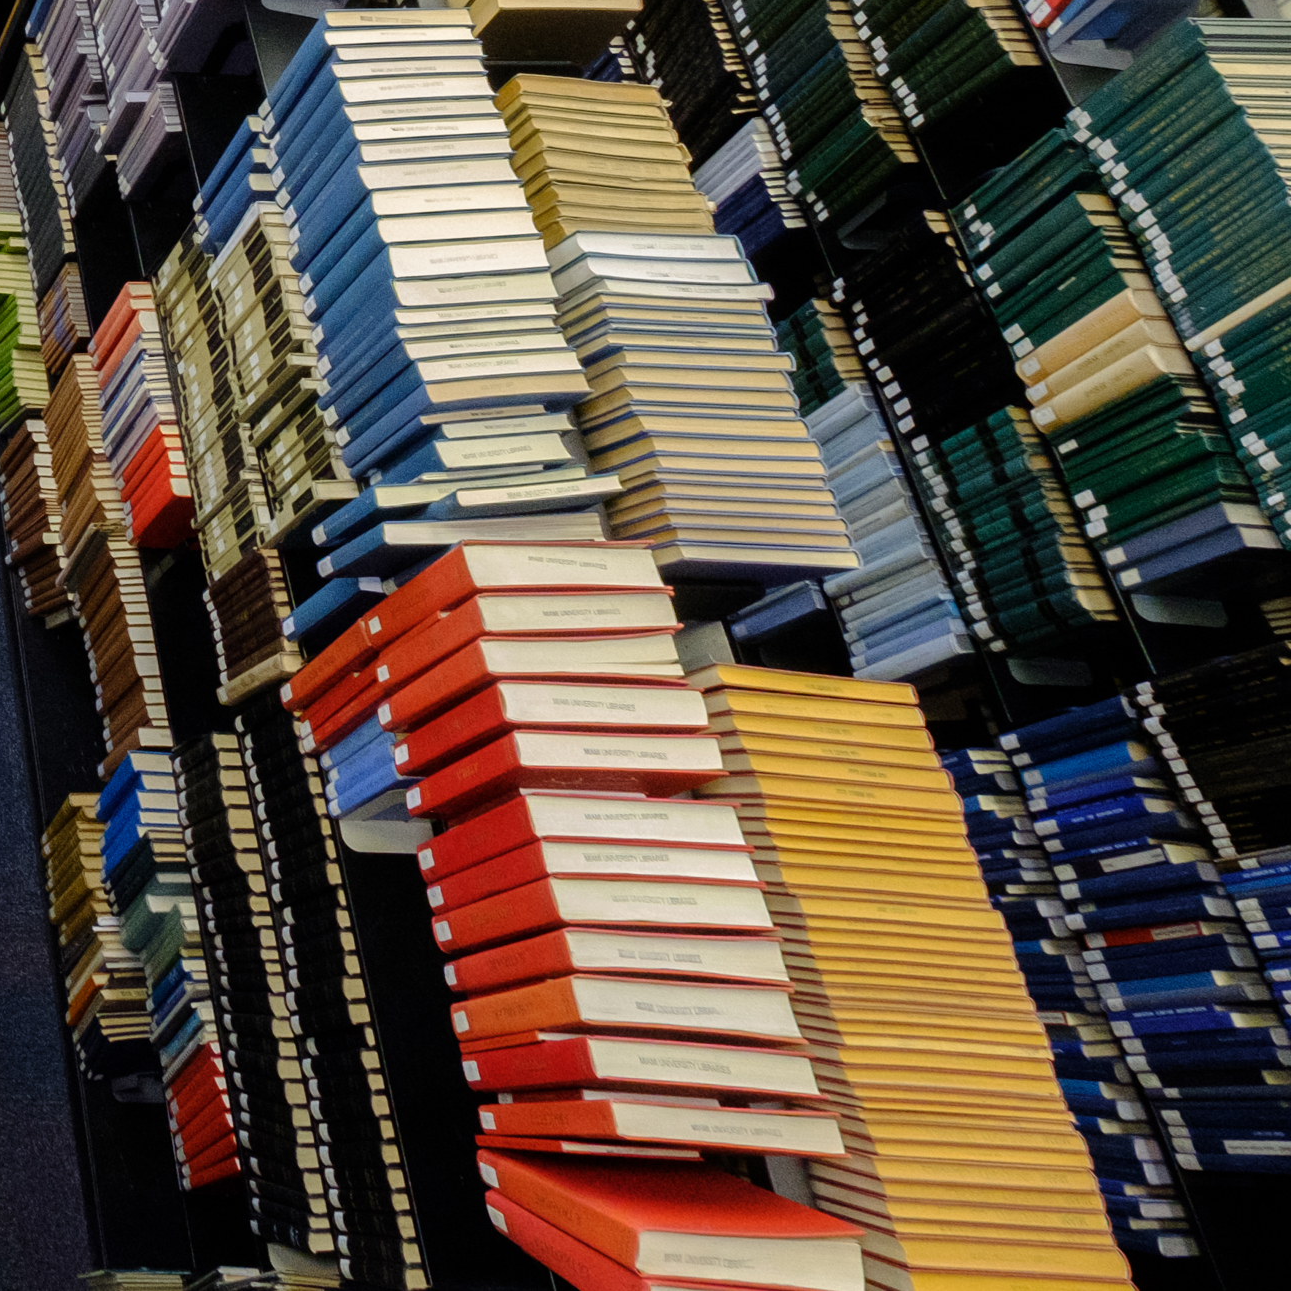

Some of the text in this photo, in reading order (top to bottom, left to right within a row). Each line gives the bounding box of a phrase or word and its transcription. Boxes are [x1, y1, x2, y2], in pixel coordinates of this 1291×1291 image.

[571, 700, 604, 708] UNIVERSITY
[602, 749, 635, 757] UNIVERSITY
[637, 751, 667, 760] LIBRARIES
[639, 1056, 731, 1075] MIAMI UNIVERSITY LIBRARIES
